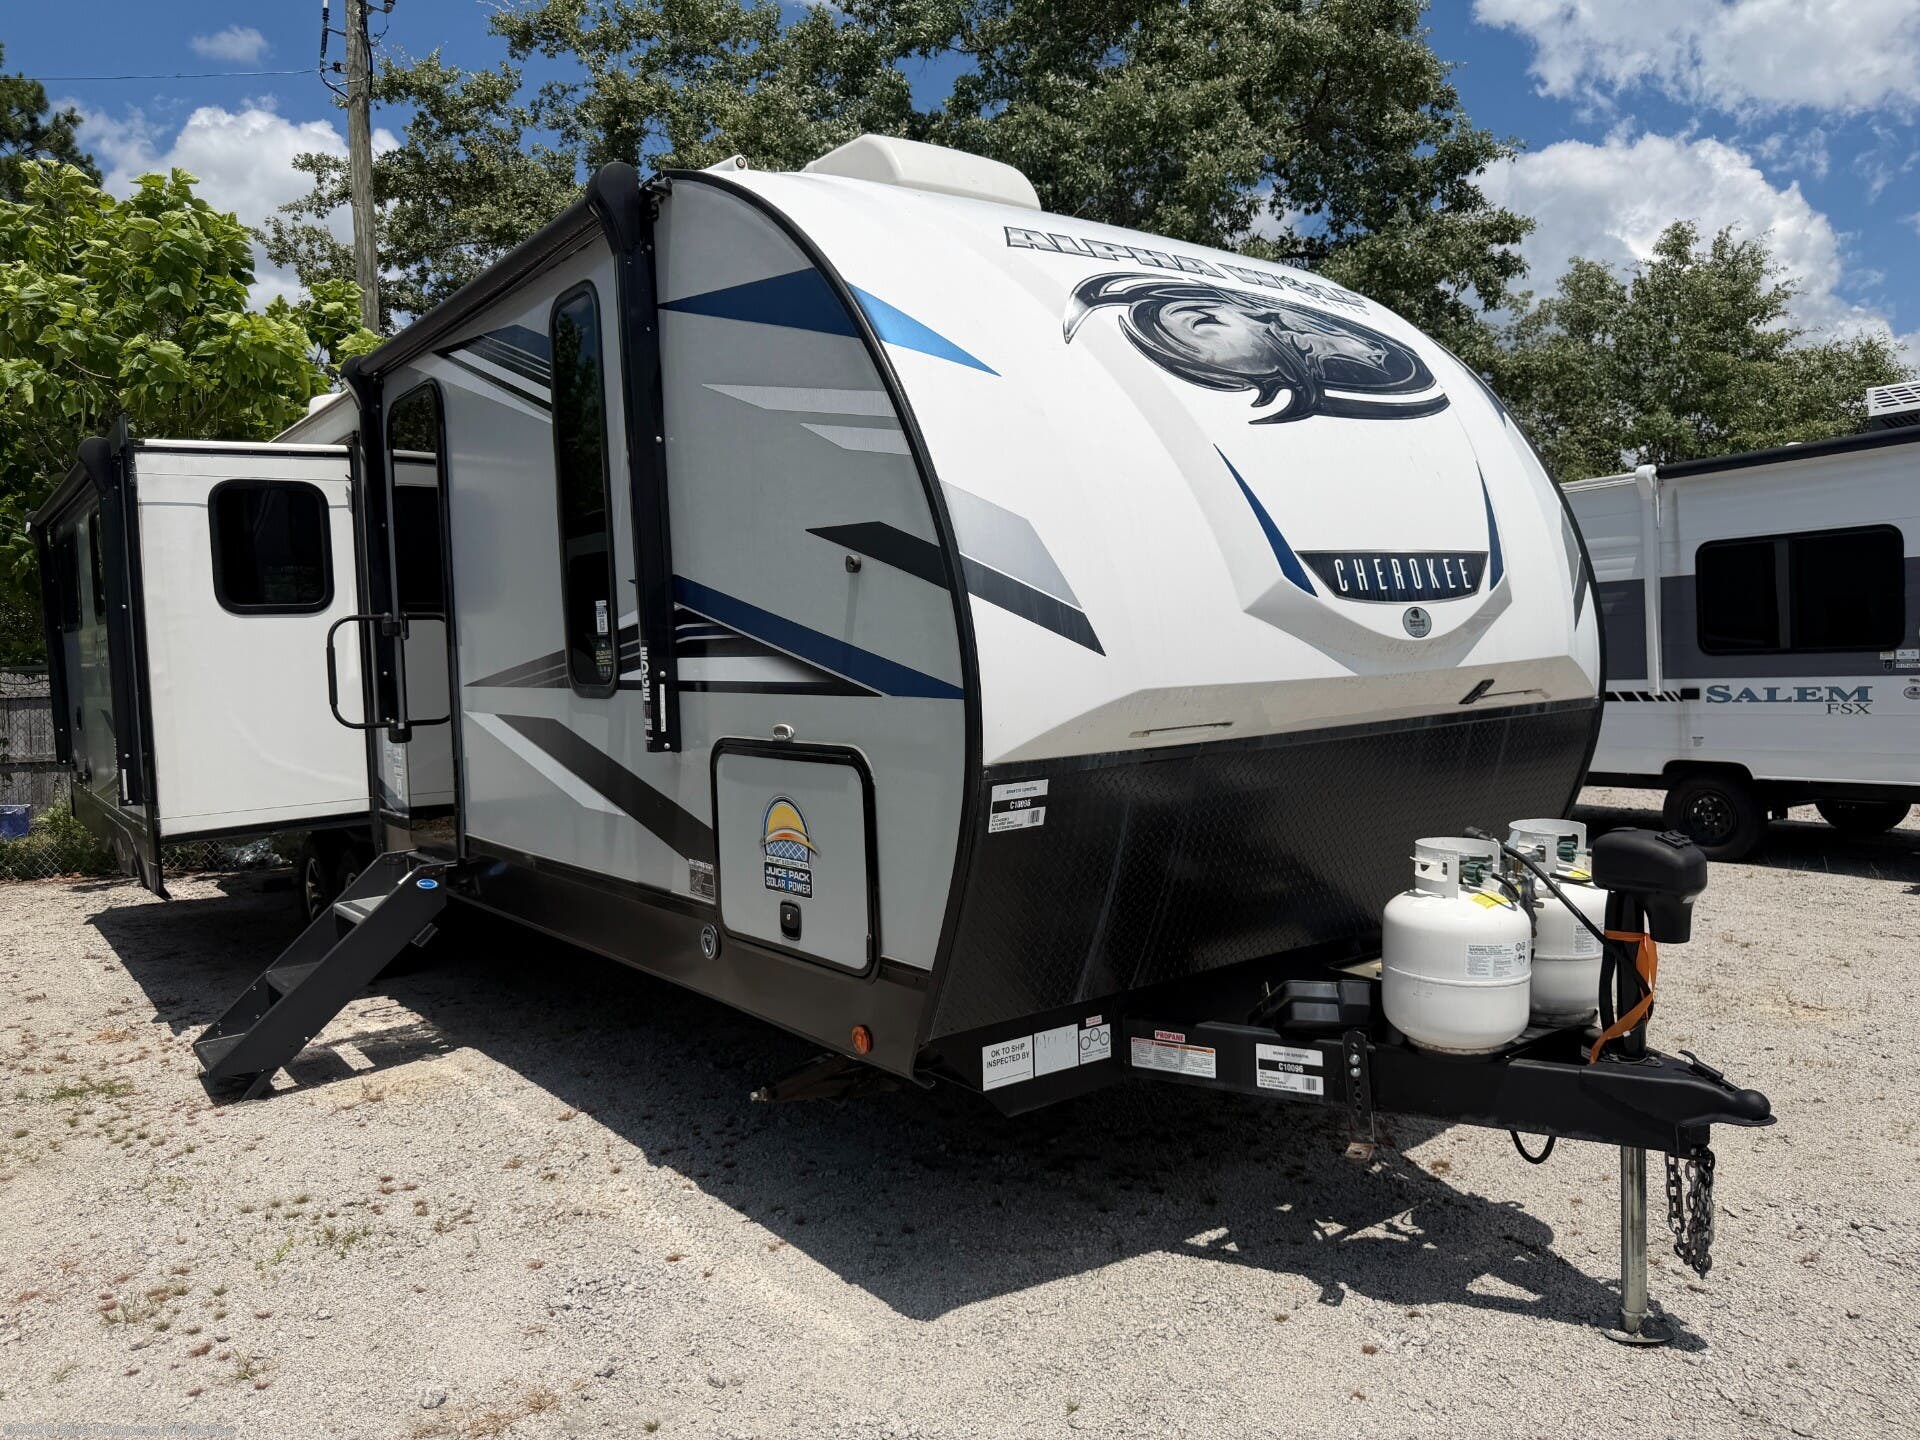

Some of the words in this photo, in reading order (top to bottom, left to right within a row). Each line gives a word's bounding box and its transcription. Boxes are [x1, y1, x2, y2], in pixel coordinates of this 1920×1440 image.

[1003, 226, 1227, 279] ALPHA
[1216, 263, 1368, 309] WOLF
[1334, 558, 1472, 592] CHEROKEE
[1706, 685, 1874, 704] SALEM
[1825, 703, 1873, 715] FSX
[765, 865, 788, 878] JUICE
[788, 870, 810, 883] PACK
[766, 876, 787, 890] SOLAR
[788, 881, 811, 896] POWER
[1155, 1031, 1184, 1042] PROPANE
[990, 1047, 1001, 1058] OK
[1002, 1045, 1010, 1055] TO
[1011, 1042, 1026, 1053] SHIP
[986, 1053, 1021, 1069] INSPECTED
[1021, 1050, 1030, 1061] BY
[1278, 1062, 1305, 1074] C10096
